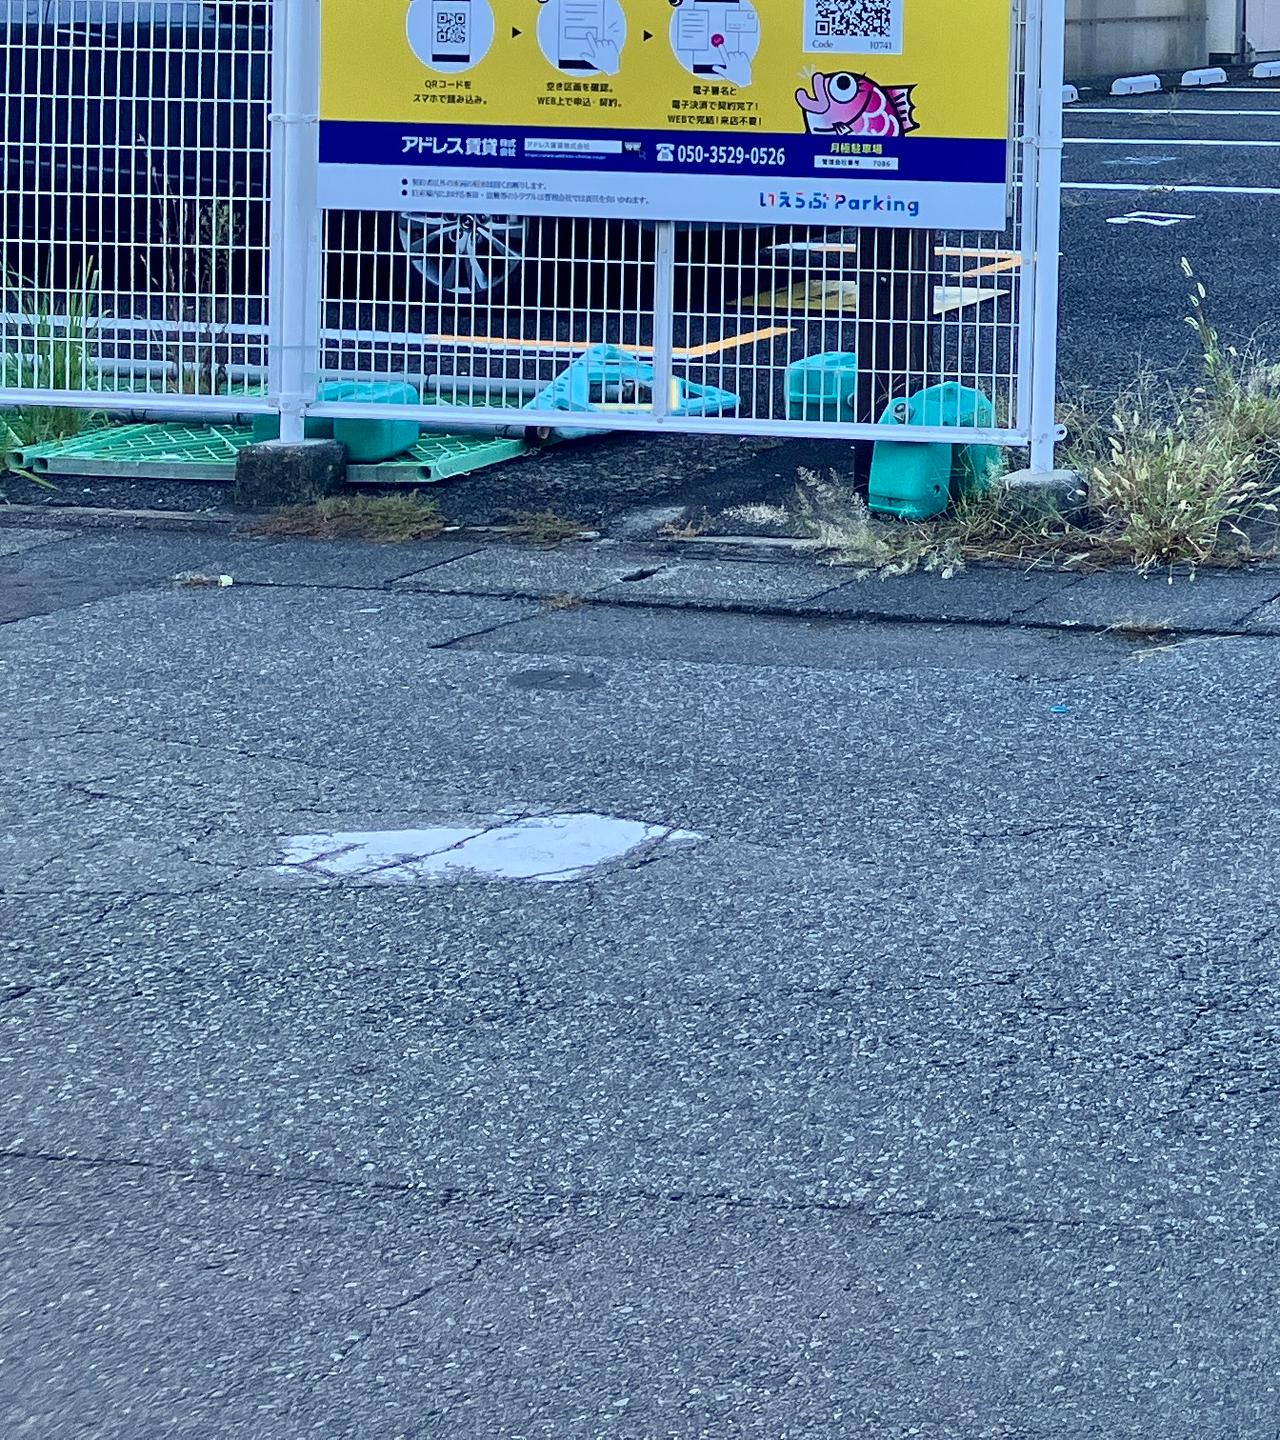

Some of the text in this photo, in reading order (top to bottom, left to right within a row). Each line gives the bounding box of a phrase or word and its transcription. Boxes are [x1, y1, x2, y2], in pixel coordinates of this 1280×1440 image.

[812, 39, 892, 51] Code 10741
[424, 79, 472, 90] QRコードを
[693, 85, 737, 96] 電子署名と
[677, 144, 786, 166] 050-3529-0526
[834, 193, 920, 217] Parking
